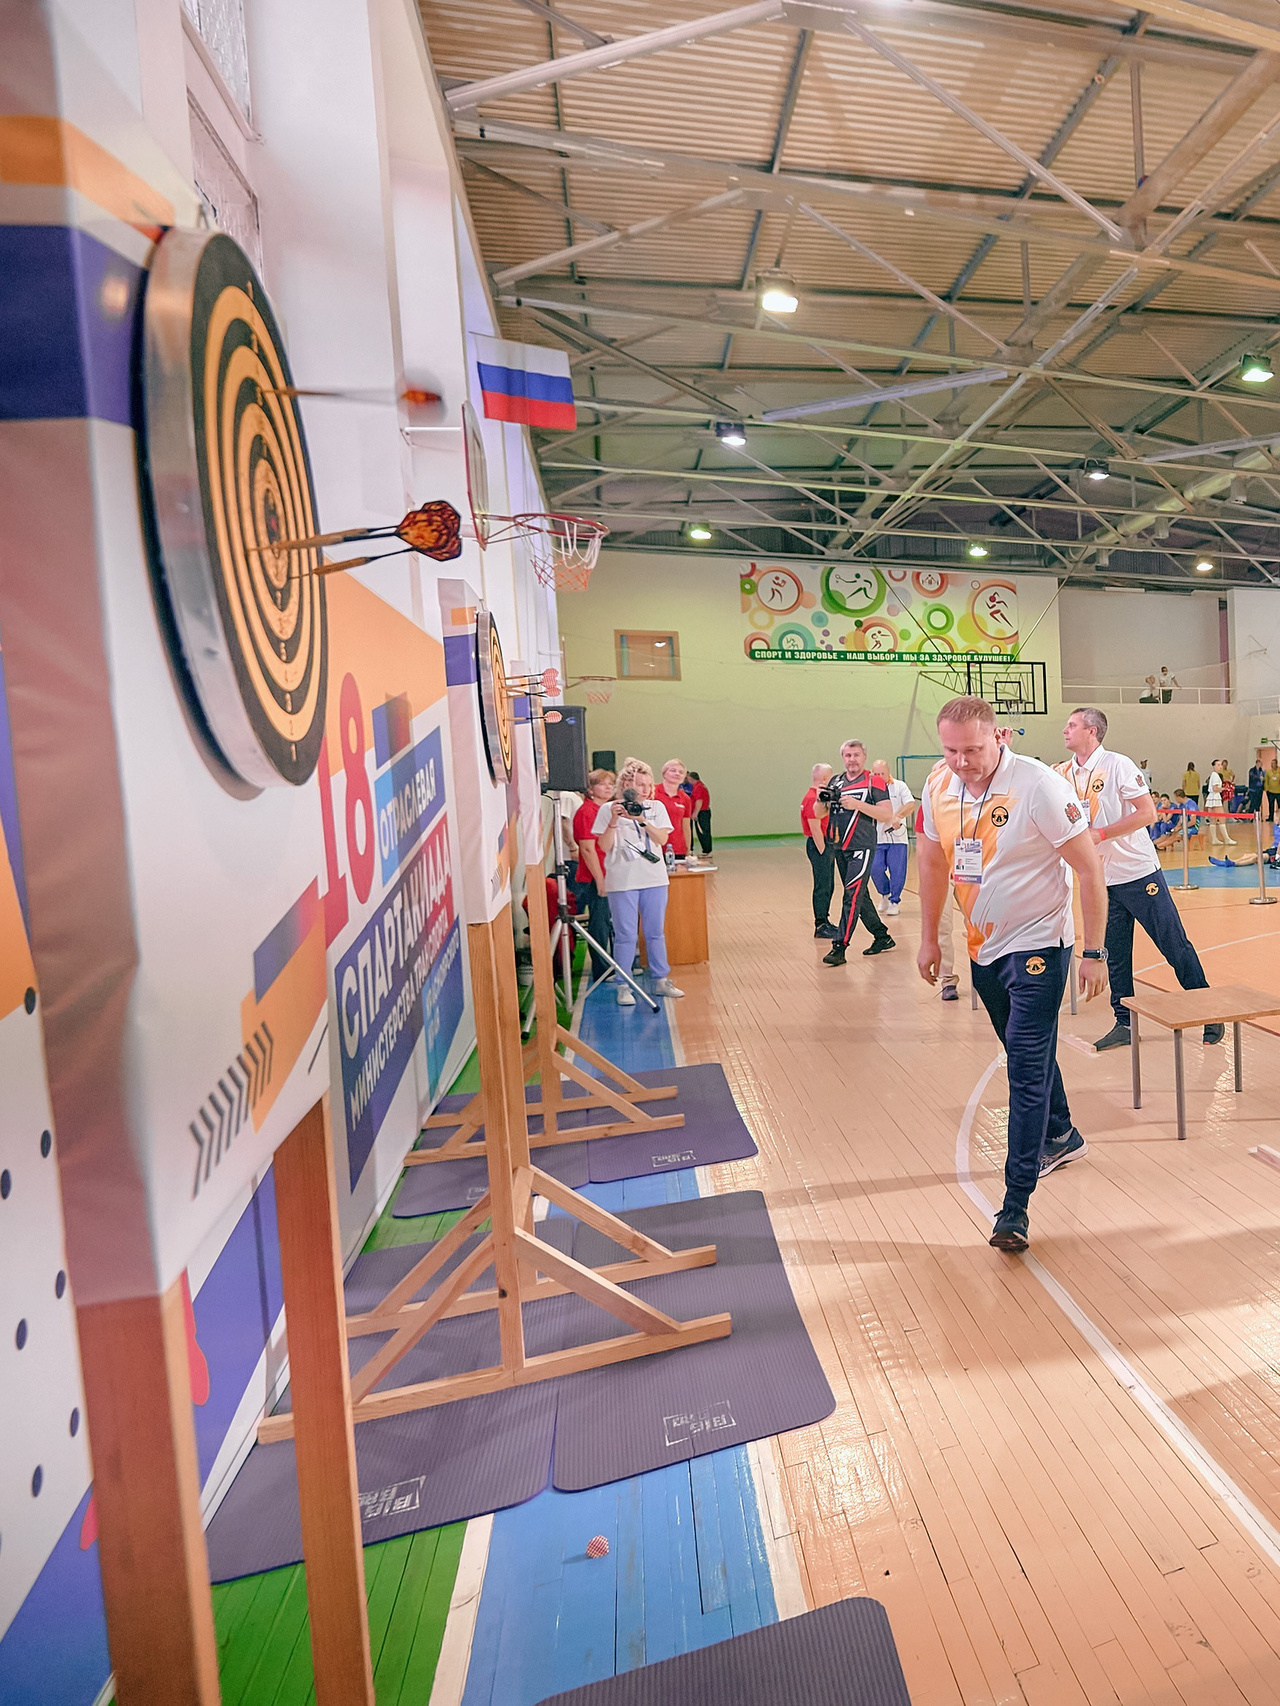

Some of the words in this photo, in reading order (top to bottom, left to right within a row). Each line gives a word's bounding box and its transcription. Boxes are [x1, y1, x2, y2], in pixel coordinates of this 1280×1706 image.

[754, 650, 782, 660] СПОРТ
[794, 652, 838, 661] ЗДОРОВЬЕ
[867, 653, 898, 662] ВЫБОР!
[903, 653, 917, 661] МЫ
[932, 654, 972, 663] ЗДОРОВОЕ
[380, 757, 437, 860] ОТРАСЛЕВАЯ
[341, 822, 452, 1059] СПАРТАКИАДА
[350, 971, 416, 1131] МИНИСТЕРСТВА
